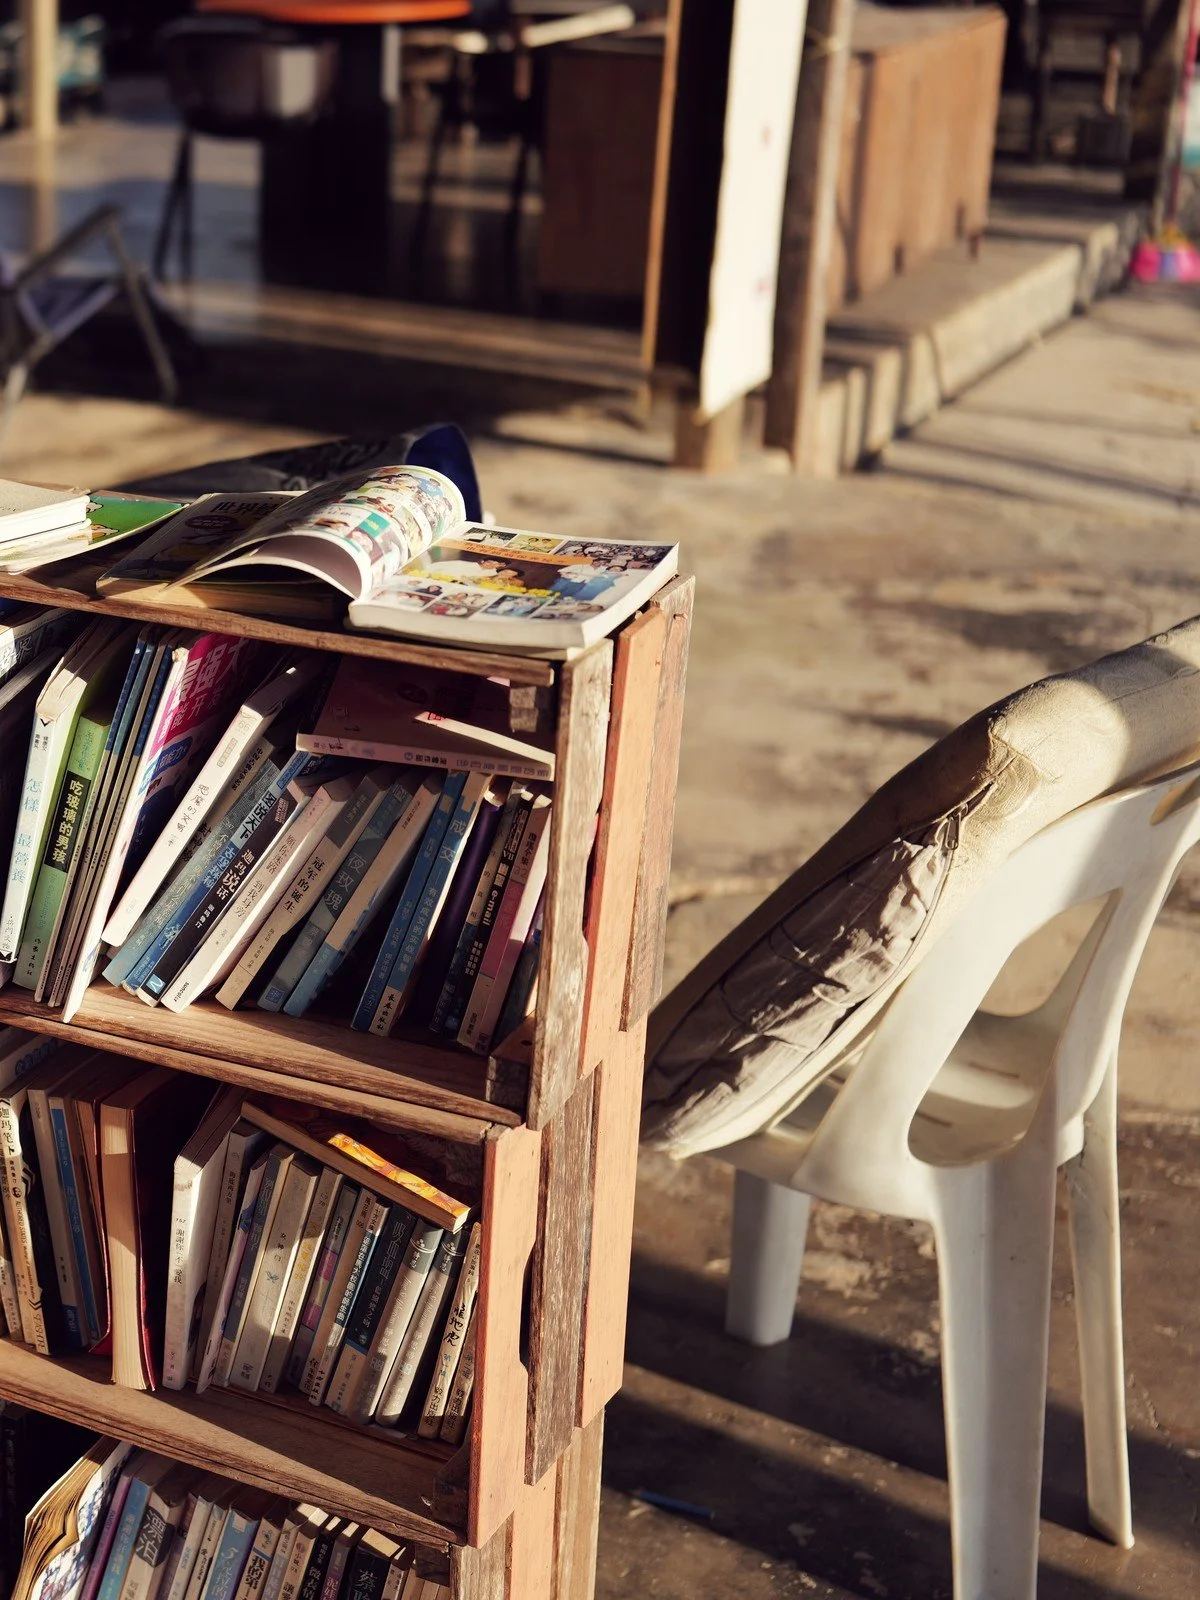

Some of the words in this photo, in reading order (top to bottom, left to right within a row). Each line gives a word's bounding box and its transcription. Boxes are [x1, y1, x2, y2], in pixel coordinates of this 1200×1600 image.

[23, 776, 43, 813] 怎樣
[52, 778, 84, 864] 吃玻璃的男孩
[10, 832, 34, 885] 最營養
[438, 818, 467, 863] 成交
[284, 856, 326, 914] 冠军的诞生
[326, 853, 368, 912] 夜玫瑰
[135, 1509, 170, 1567] 漂泊
